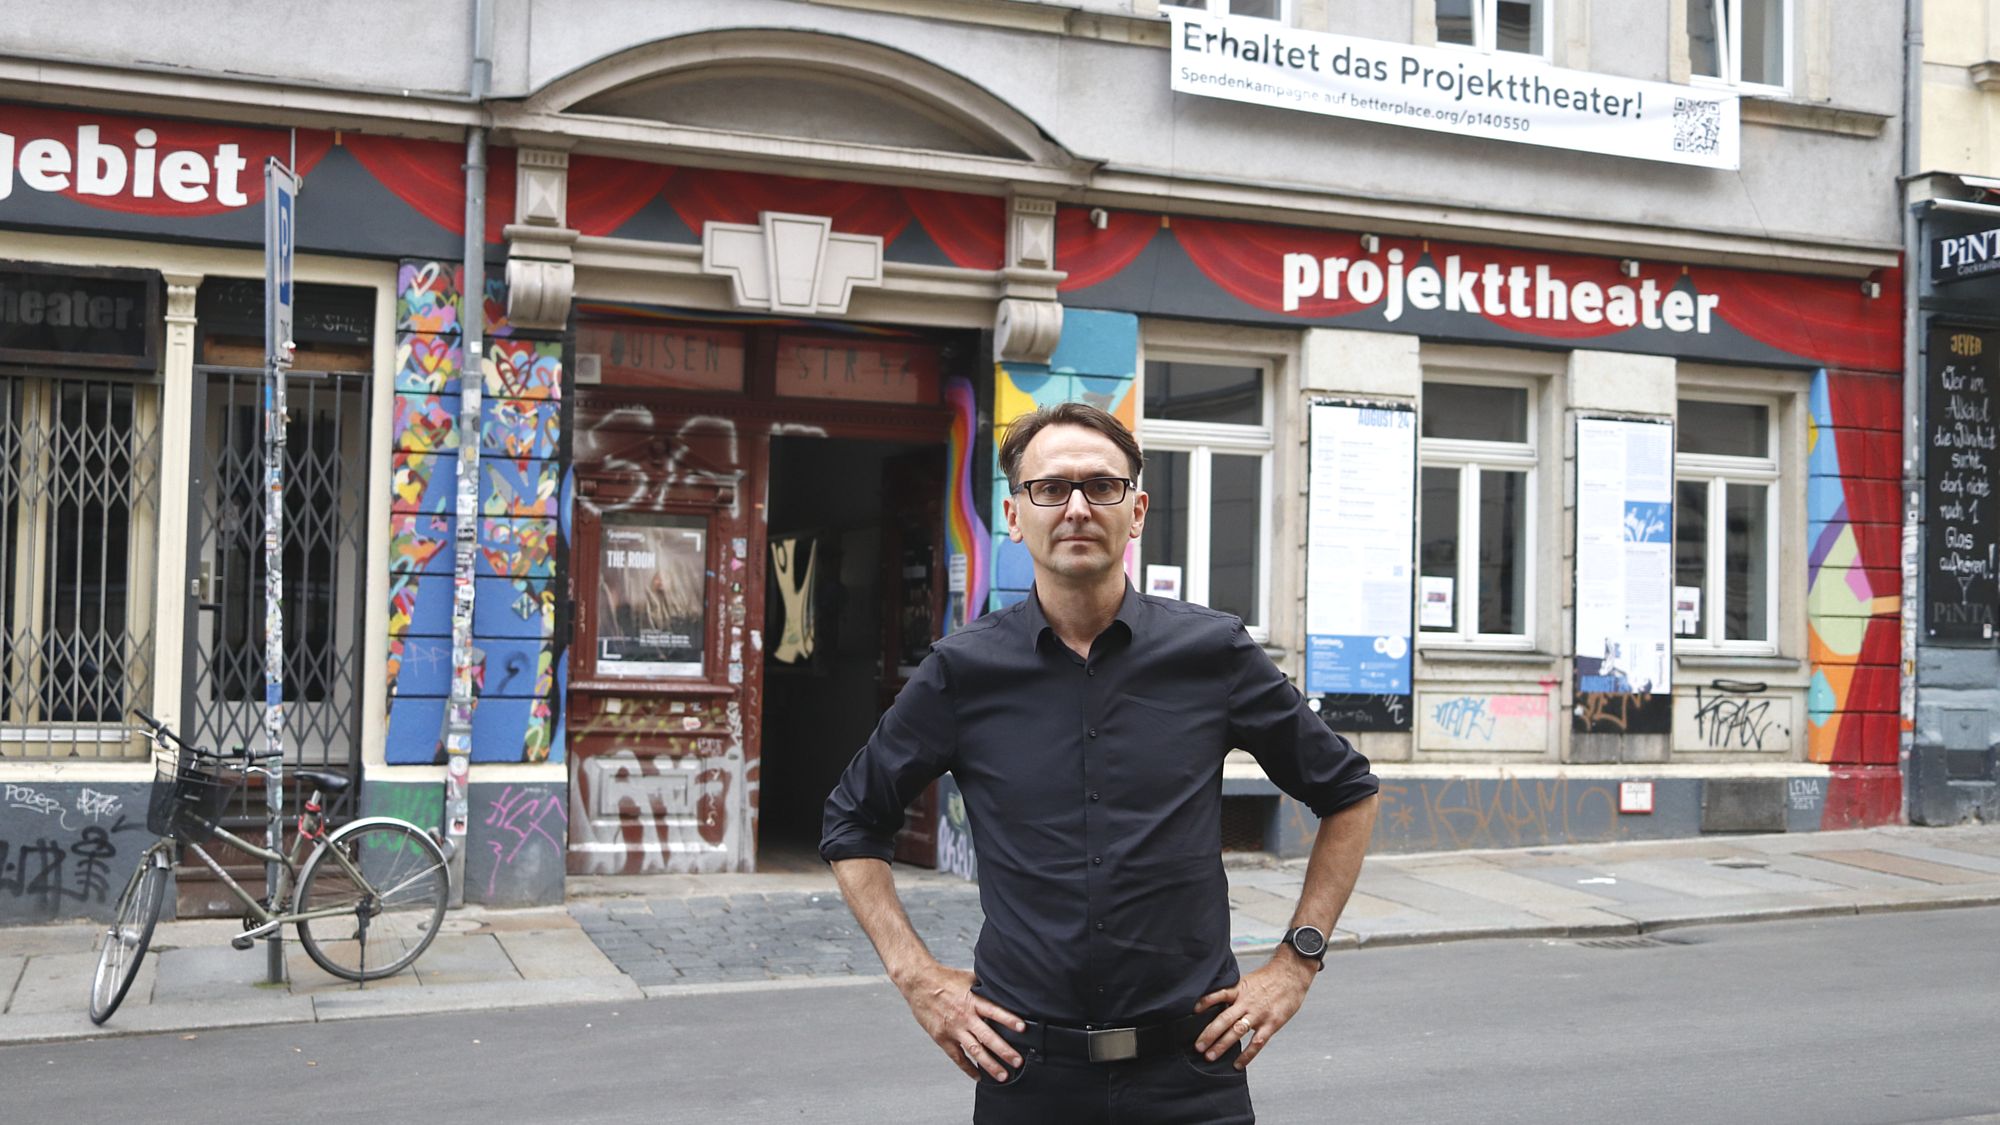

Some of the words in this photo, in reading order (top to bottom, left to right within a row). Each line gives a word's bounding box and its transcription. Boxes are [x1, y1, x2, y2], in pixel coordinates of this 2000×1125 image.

[1183, 21, 1320, 72] Erhaltet
[1332, 46, 1388, 82] das
[1401, 56, 1643, 119] Projekttheater!
[1181, 67, 1319, 102] Spendenkampagne
[1324, 91, 1347, 104] auf
[1351, 93, 1530, 133] betterplace.org/p140550
[1283, 248, 1719, 334] projekttheater
[1950, 333, 1982, 356] JEVER
[1942, 365, 1967, 391] Wer
[1970, 366, 1987, 394] im
[1933, 425, 1952, 448] die
[1939, 471, 1964, 498] darf
[1968, 499, 1979, 525] 1
[1945, 526, 1974, 550] Glas
[607, 550, 625, 568] THE
[1932, 601, 1996, 624] PiNTA
[1789, 779, 1820, 797] LENA
